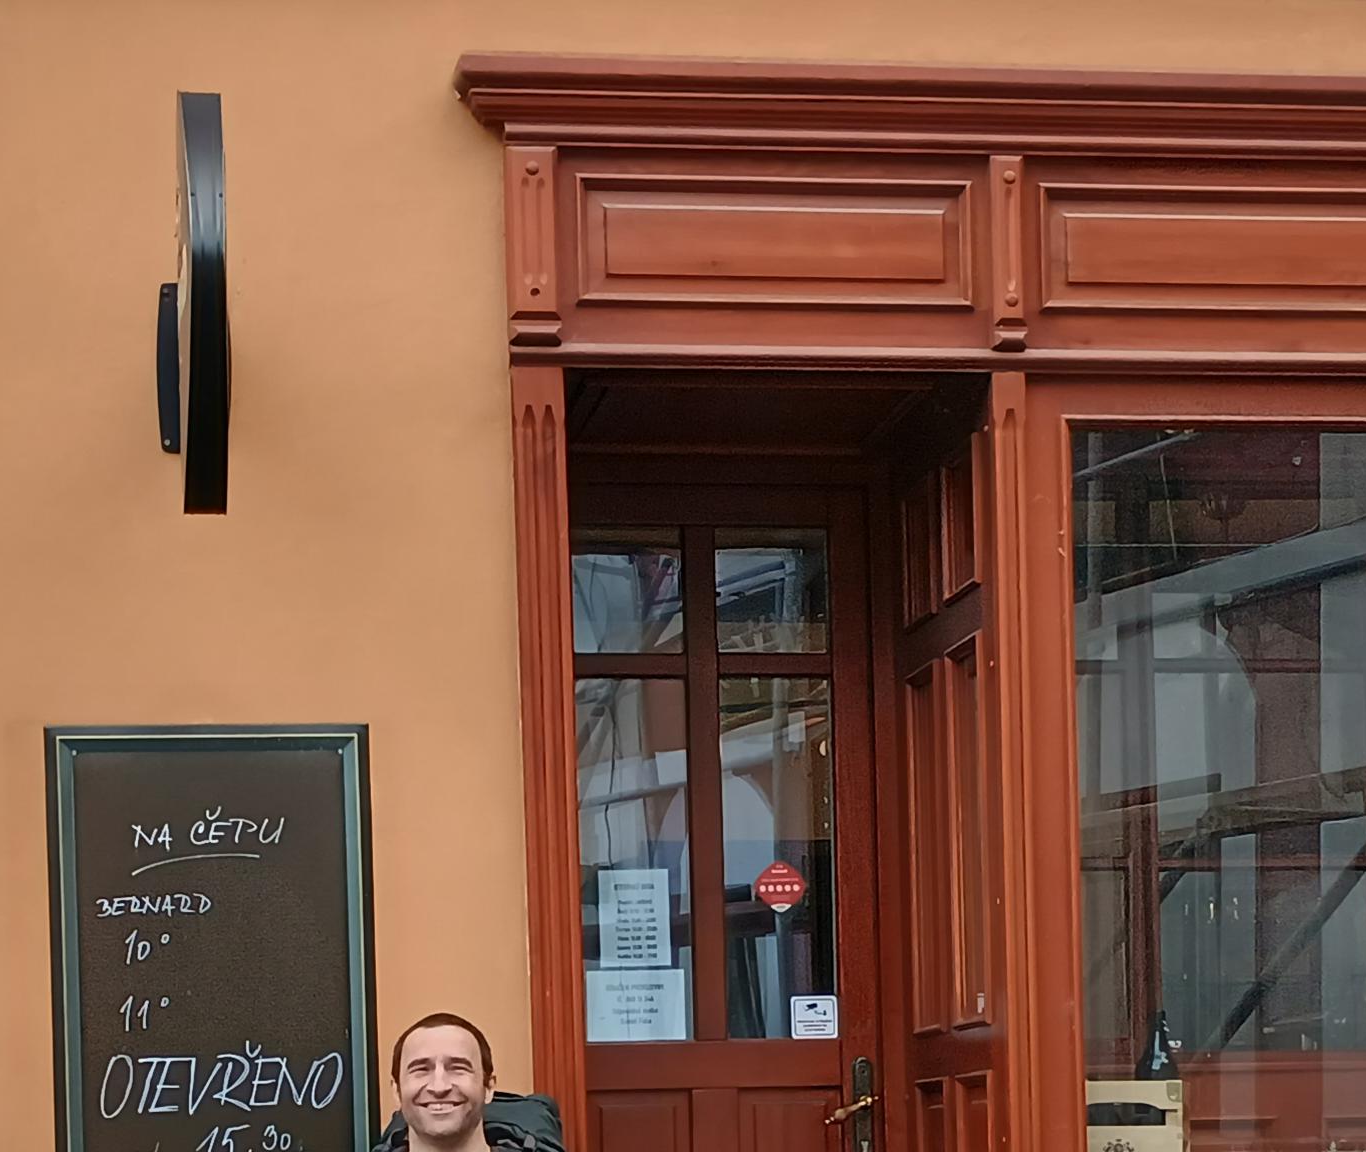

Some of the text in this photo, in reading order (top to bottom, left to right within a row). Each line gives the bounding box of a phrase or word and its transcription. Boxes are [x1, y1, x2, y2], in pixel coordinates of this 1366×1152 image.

[131, 823, 173, 850] NA
[96, 893, 212, 917] BERNARD
[99, 1040, 344, 1119] OTEVŘENO
